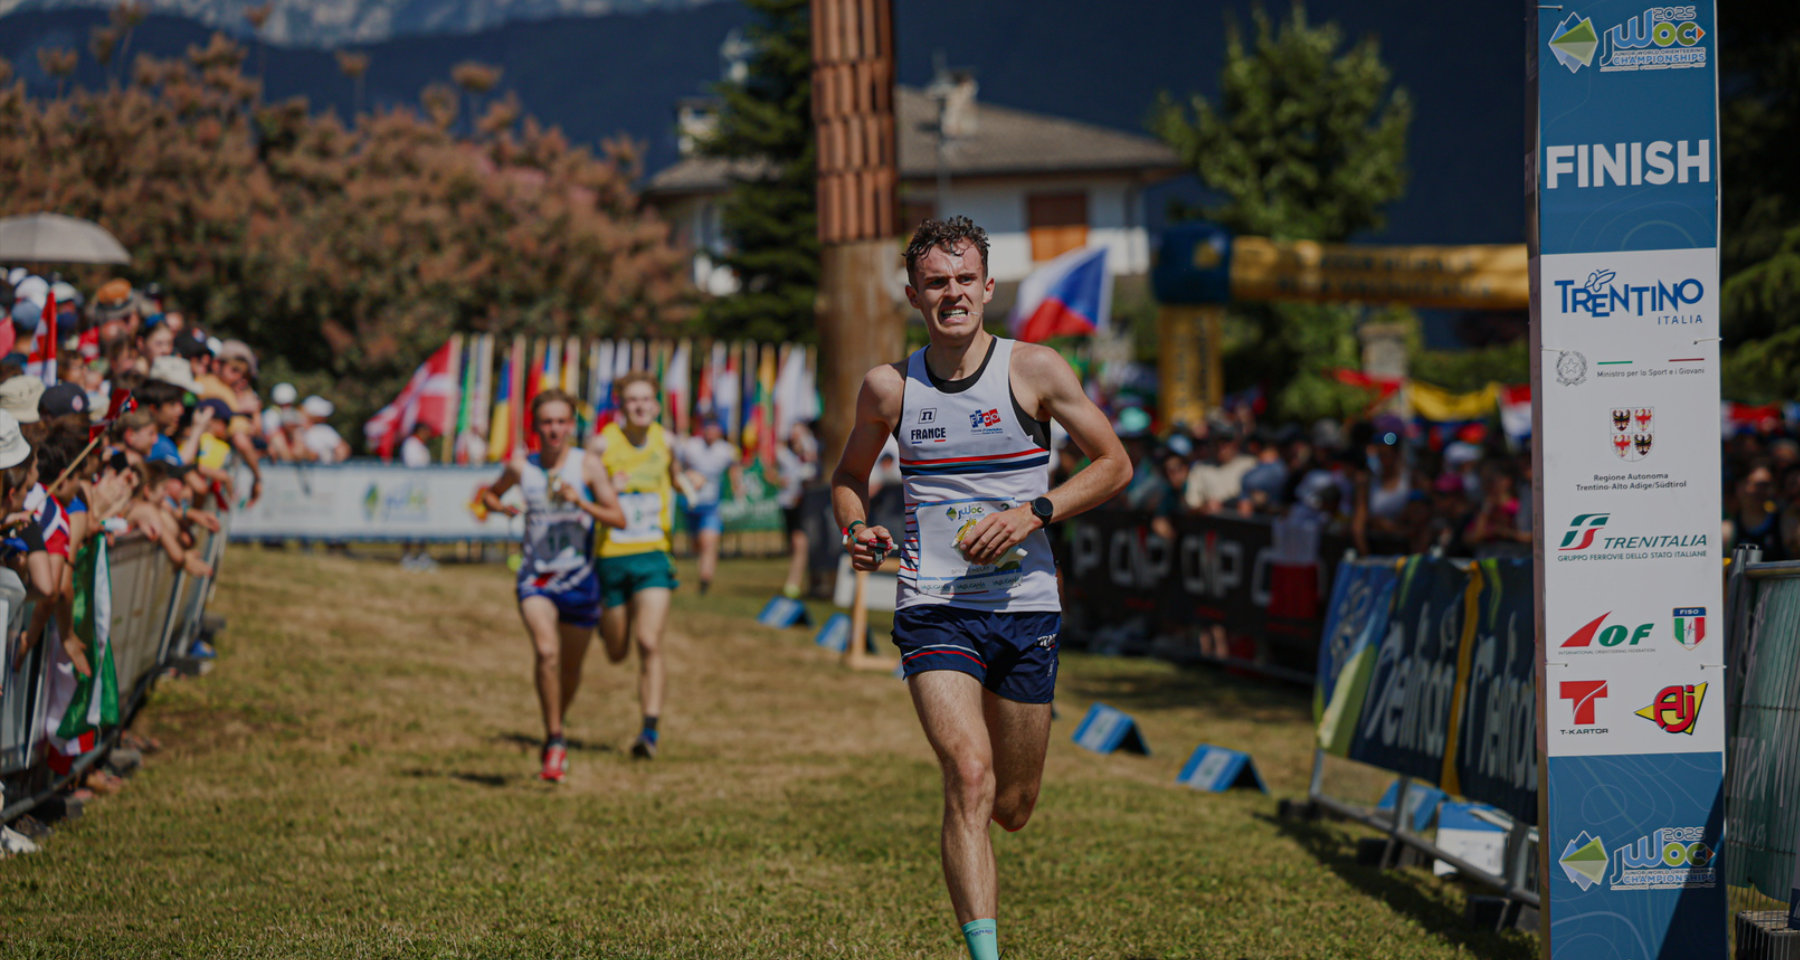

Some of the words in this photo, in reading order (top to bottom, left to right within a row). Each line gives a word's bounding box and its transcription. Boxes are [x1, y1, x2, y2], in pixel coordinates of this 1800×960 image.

[1653, 6, 1696, 21] 2025
[1613, 53, 1705, 65] CHAMPIONSHIPS
[1546, 139, 1710, 189] FINISH
[1554, 278, 1704, 318] TRENTINO
[1658, 315, 1703, 325] ITALIA
[1597, 370, 1625, 378] Ministro
[1648, 369, 1667, 377] Sport
[911, 427, 946, 440] FRANCE
[1593, 474, 1626, 483] Regione
[1628, 473, 1669, 481] Autonoma
[1576, 481, 1628, 491] Trentino-Alto
[1630, 480, 1687, 491] Adige/Südtirol
[1604, 534, 1707, 549] TRENITALIA
[1557, 554, 1588, 562] GRUPPO
[1590, 553, 1624, 561] FERROVIE
[1626, 552, 1648, 560] DELLO
[1650, 551, 1673, 559] STATO
[1674, 550, 1707, 558] ITALIANE
[1664, 826, 1705, 841] 2025
[1624, 874, 1716, 884] CHAMPIONSHIPS
